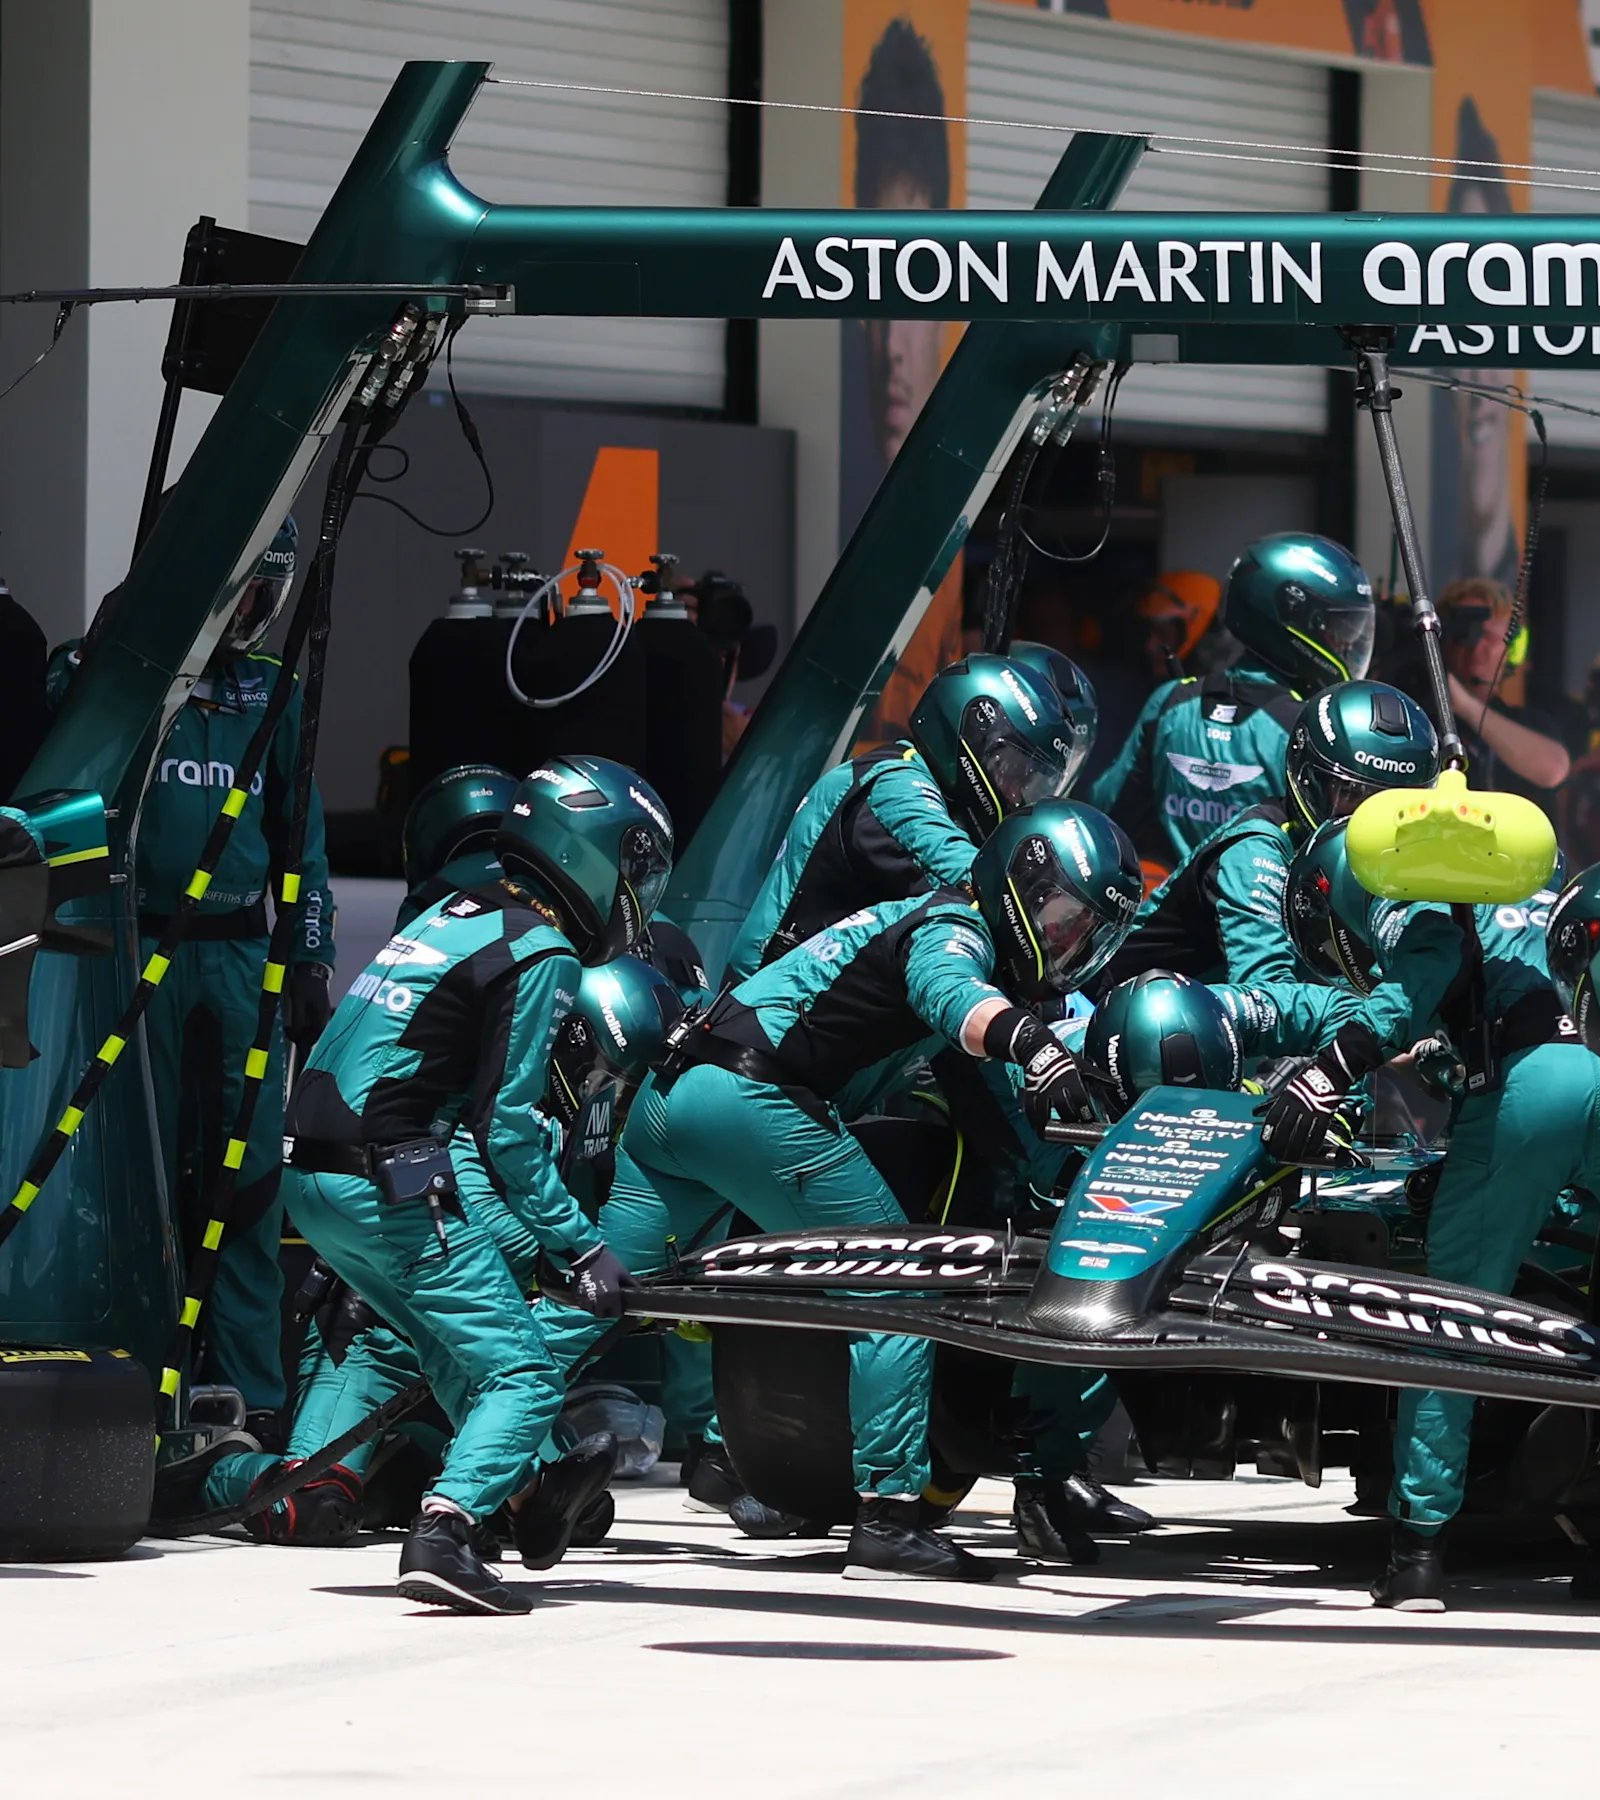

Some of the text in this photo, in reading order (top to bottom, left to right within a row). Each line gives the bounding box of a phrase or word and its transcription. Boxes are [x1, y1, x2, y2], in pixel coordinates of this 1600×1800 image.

[762, 236, 1008, 304] ASTON
[1036, 241, 1323, 304] MARTIN
[265, 550, 295, 564] amco
[226, 691, 268, 702] armco
[1354, 750, 1416, 774] aramco
[160, 758, 263, 796] ramo
[960, 755, 977, 785] ASTON
[973, 782, 996, 817] MARTIN
[1261, 859, 1288, 877] NexG
[204, 891, 243, 904] RIFFITHS
[619, 894, 634, 945] ASTON MARTIN
[1002, 893, 1035, 960] ASTON MARTIN
[1338, 928, 1371, 993] ASTON MARTIN
[348, 973, 412, 1013] amco
[600, 994, 628, 1052] lvoline
[551, 1074, 567, 1106] ASTON
[1303, 1067, 1333, 1094] OMP
[1134, 1123, 1246, 1140] VELOCITY
[1139, 1112, 1254, 1131] NexGen
[1116, 1142, 1229, 1159] servicenow
[1154, 1132, 1213, 1142] BLACK
[1105, 1152, 1221, 1171] NetApp
[1089, 1181, 1193, 1198] PIRELLI
[701, 1235, 996, 1277] aramco
[1250, 1263, 1595, 1360] aramco
